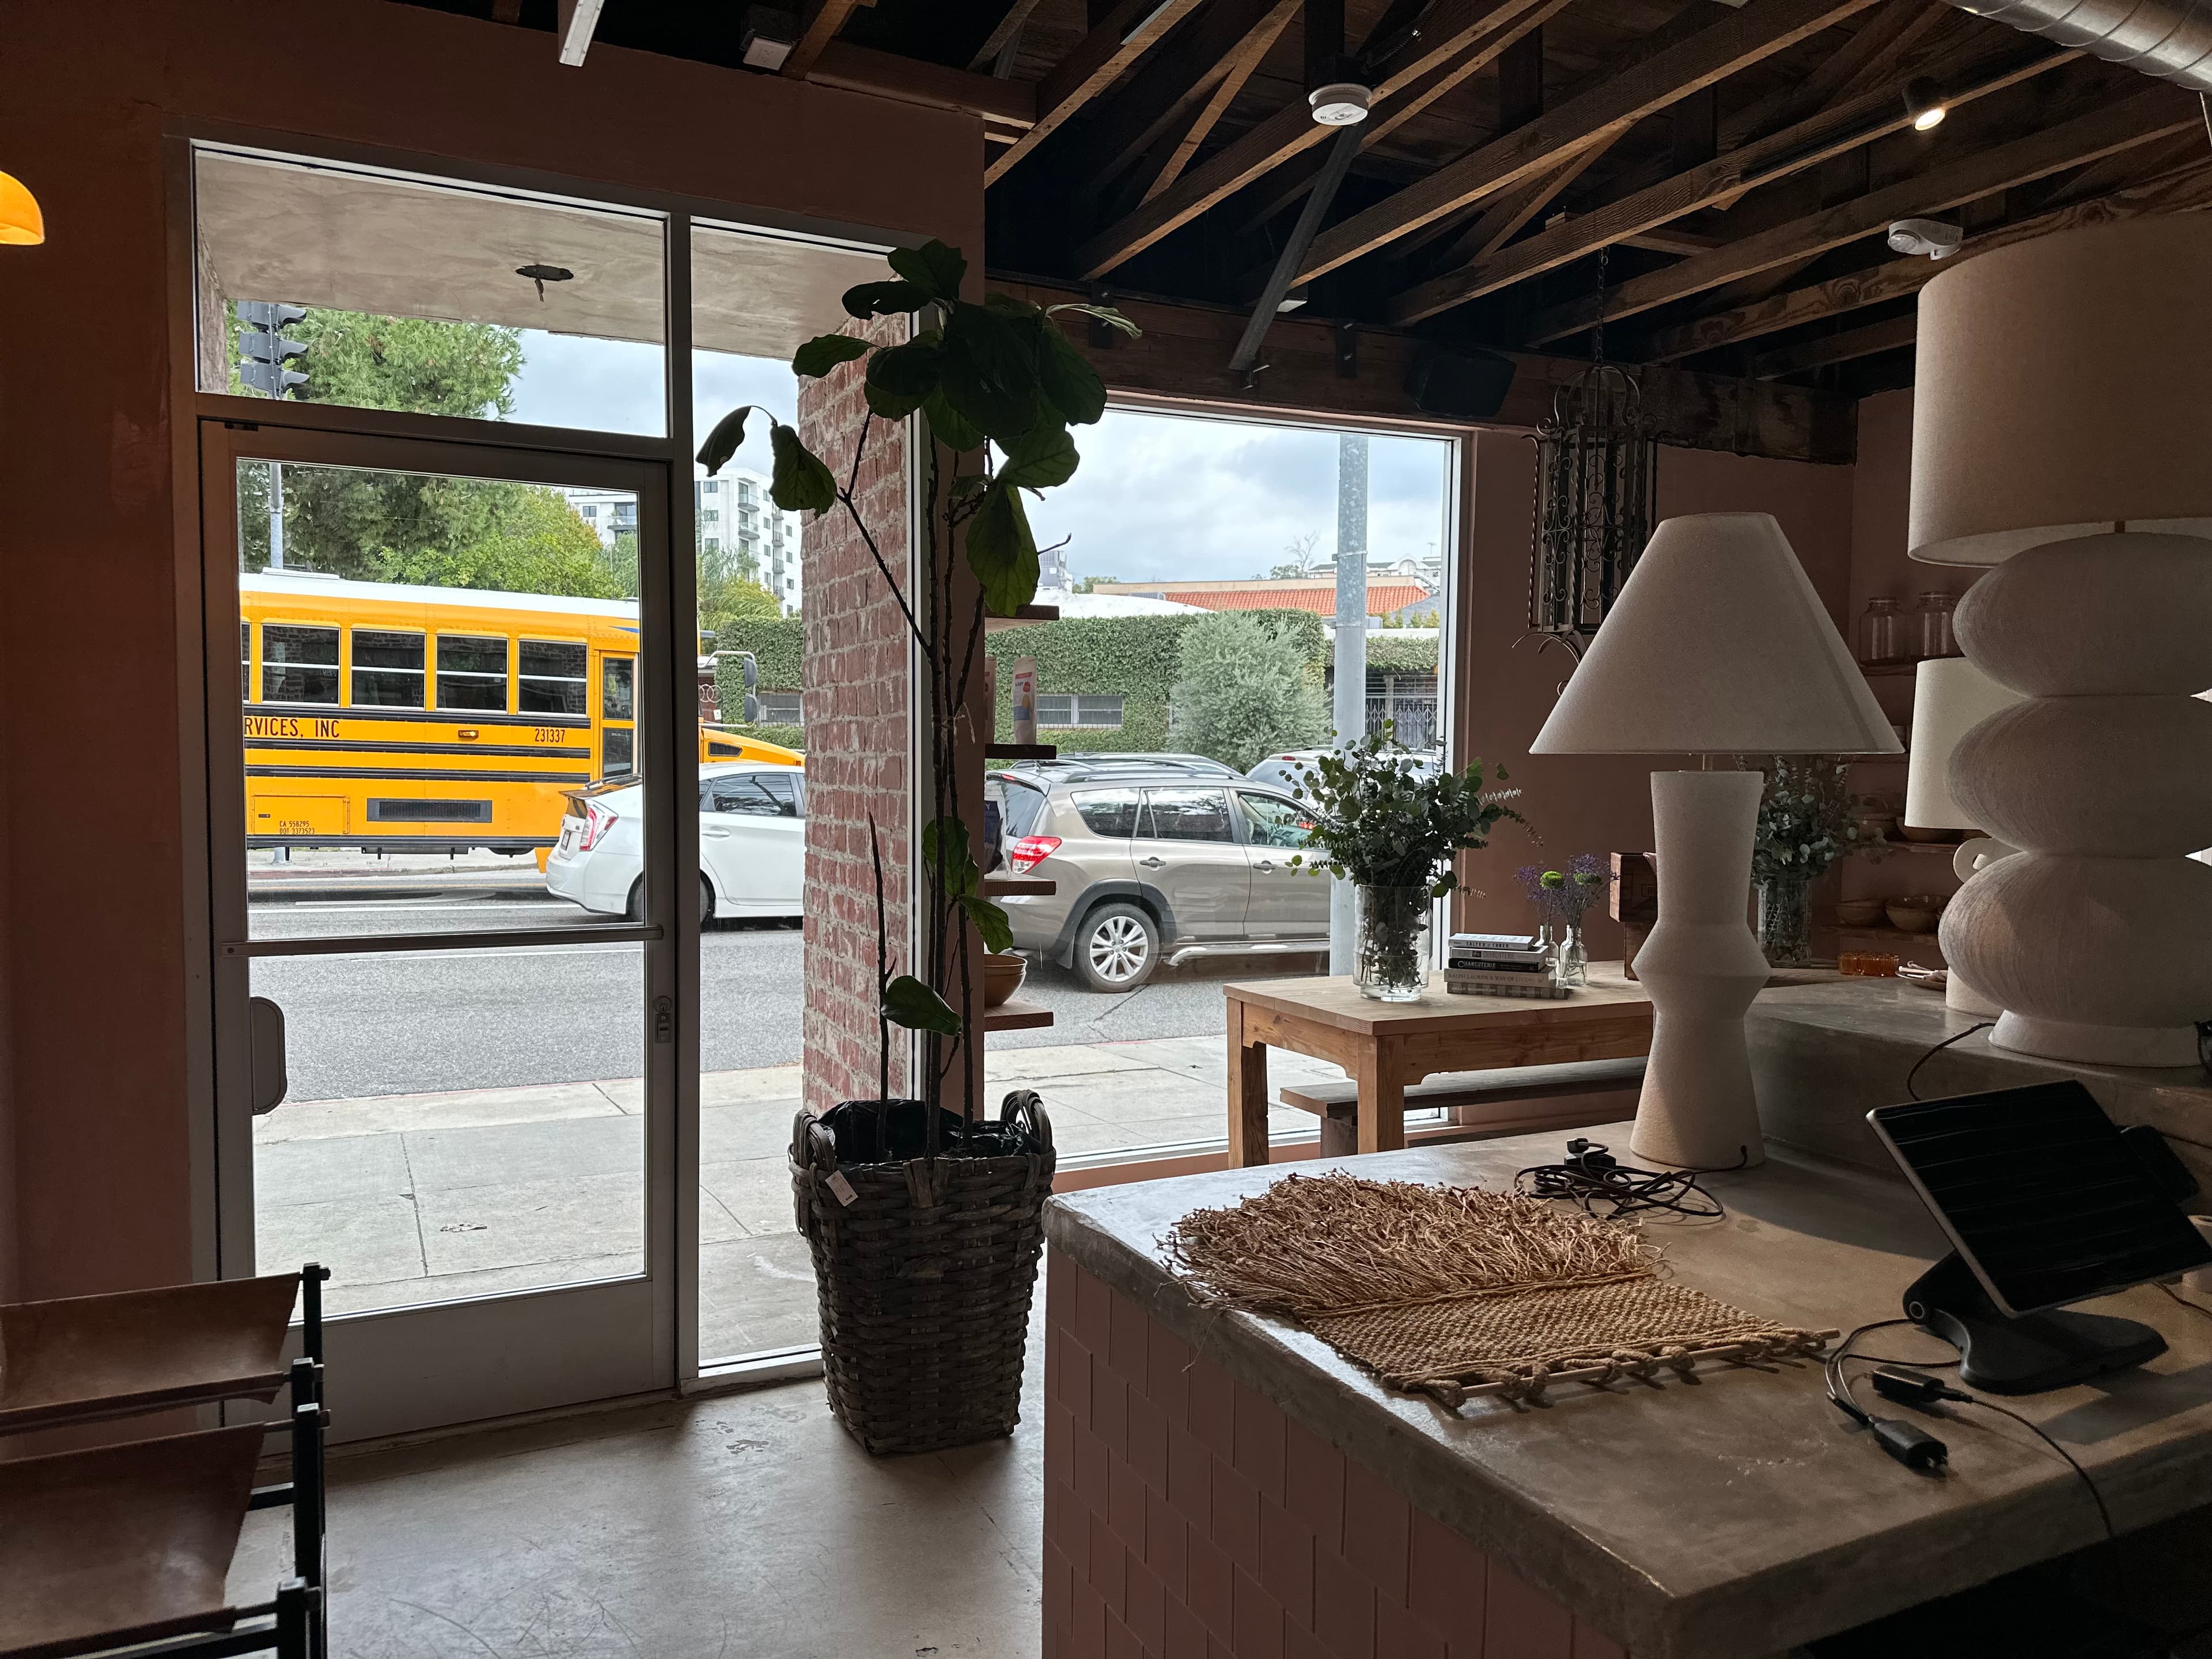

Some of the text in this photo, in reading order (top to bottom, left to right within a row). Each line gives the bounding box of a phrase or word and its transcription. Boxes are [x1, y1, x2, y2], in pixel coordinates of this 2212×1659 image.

[244, 717, 340, 738] RVICES, INC
[535, 728, 565, 743] 231337
